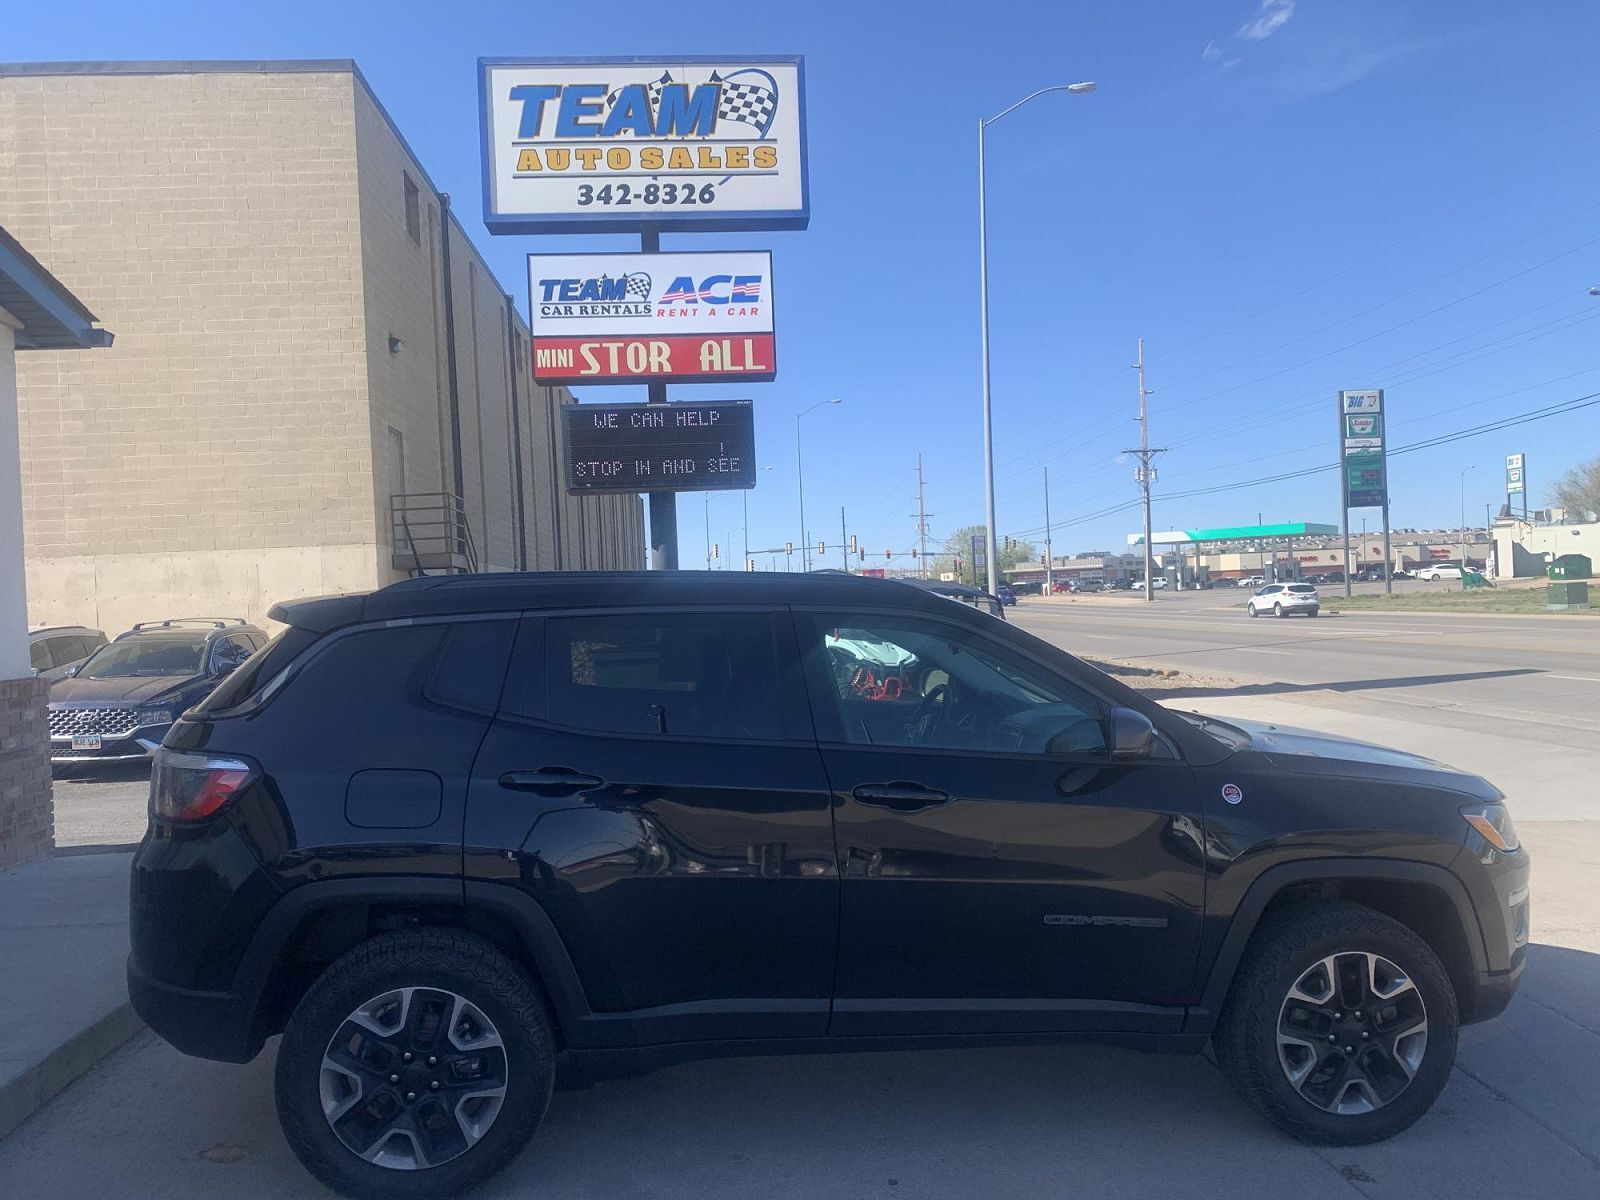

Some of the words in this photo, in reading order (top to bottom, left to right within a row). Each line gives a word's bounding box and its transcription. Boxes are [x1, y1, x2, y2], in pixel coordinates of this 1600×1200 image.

[509, 82, 724, 139] TEAM
[516, 148, 631, 171] AUTO
[639, 146, 778, 170] SALES
[577, 183, 716, 206] 342-8326
[539, 277, 627, 303] TEAM
[658, 275, 762, 304] ACE
[541, 305, 573, 316] CAR
[579, 303, 652, 316] RENTALS
[657, 308, 699, 317] RENT
[708, 308, 717, 316] A
[727, 307, 759, 316] CAR
[537, 349, 573, 368] MINI
[580, 341, 672, 374] STOR
[700, 339, 766, 372] ALL
[593, 413, 619, 428] WE
[630, 412, 664, 428] CAN
[676, 411, 720, 426] HELP
[576, 461, 623, 476] STOP
[635, 460, 651, 475] IN
[663, 459, 695, 474] AND
[708, 457, 740, 473] SEE
